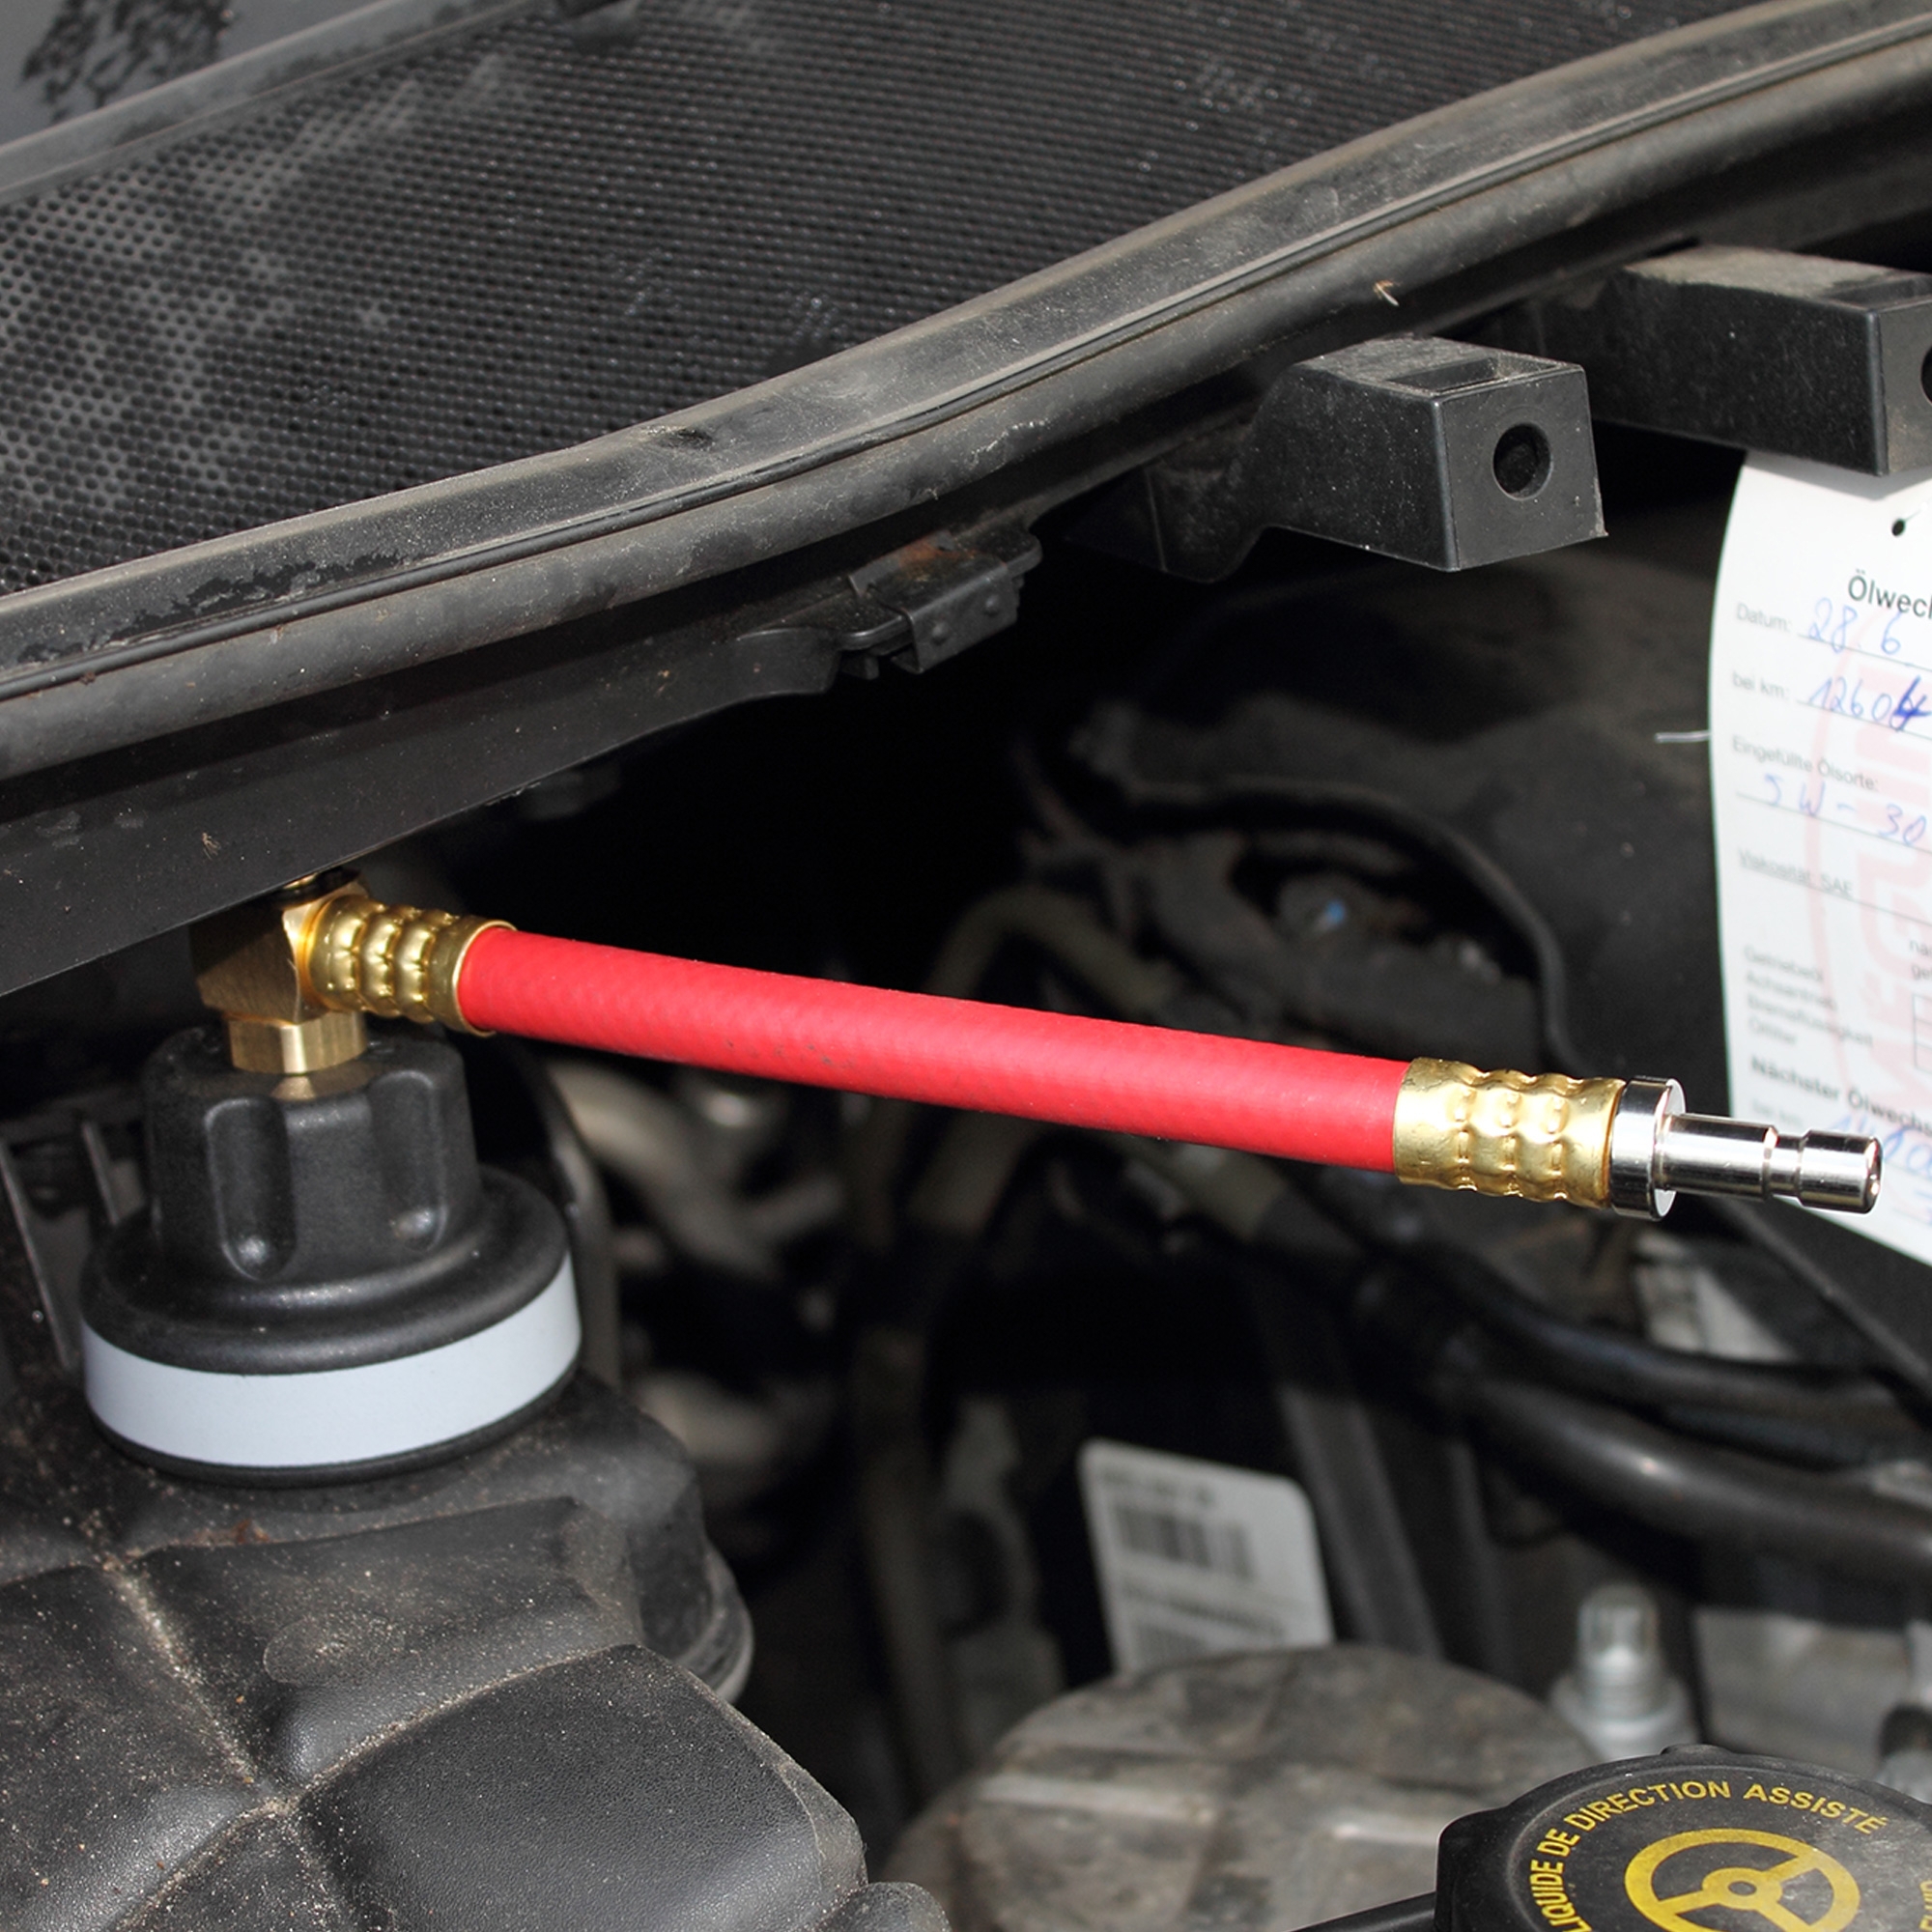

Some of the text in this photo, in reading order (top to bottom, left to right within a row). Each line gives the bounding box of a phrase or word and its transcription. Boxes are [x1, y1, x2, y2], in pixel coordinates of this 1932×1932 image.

[1736, 601, 1792, 632] Datum:
[1732, 670, 1756, 691] bei
[1732, 733, 1879, 792] Eingefüllte Ölsorte:
[1750, 1054, 1839, 1101] Nächster
[1536, 1828, 1581, 1858] DE
[1563, 1780, 1731, 1832] DIRECTION
[1743, 1783, 1889, 1834] ASSISTÉ
